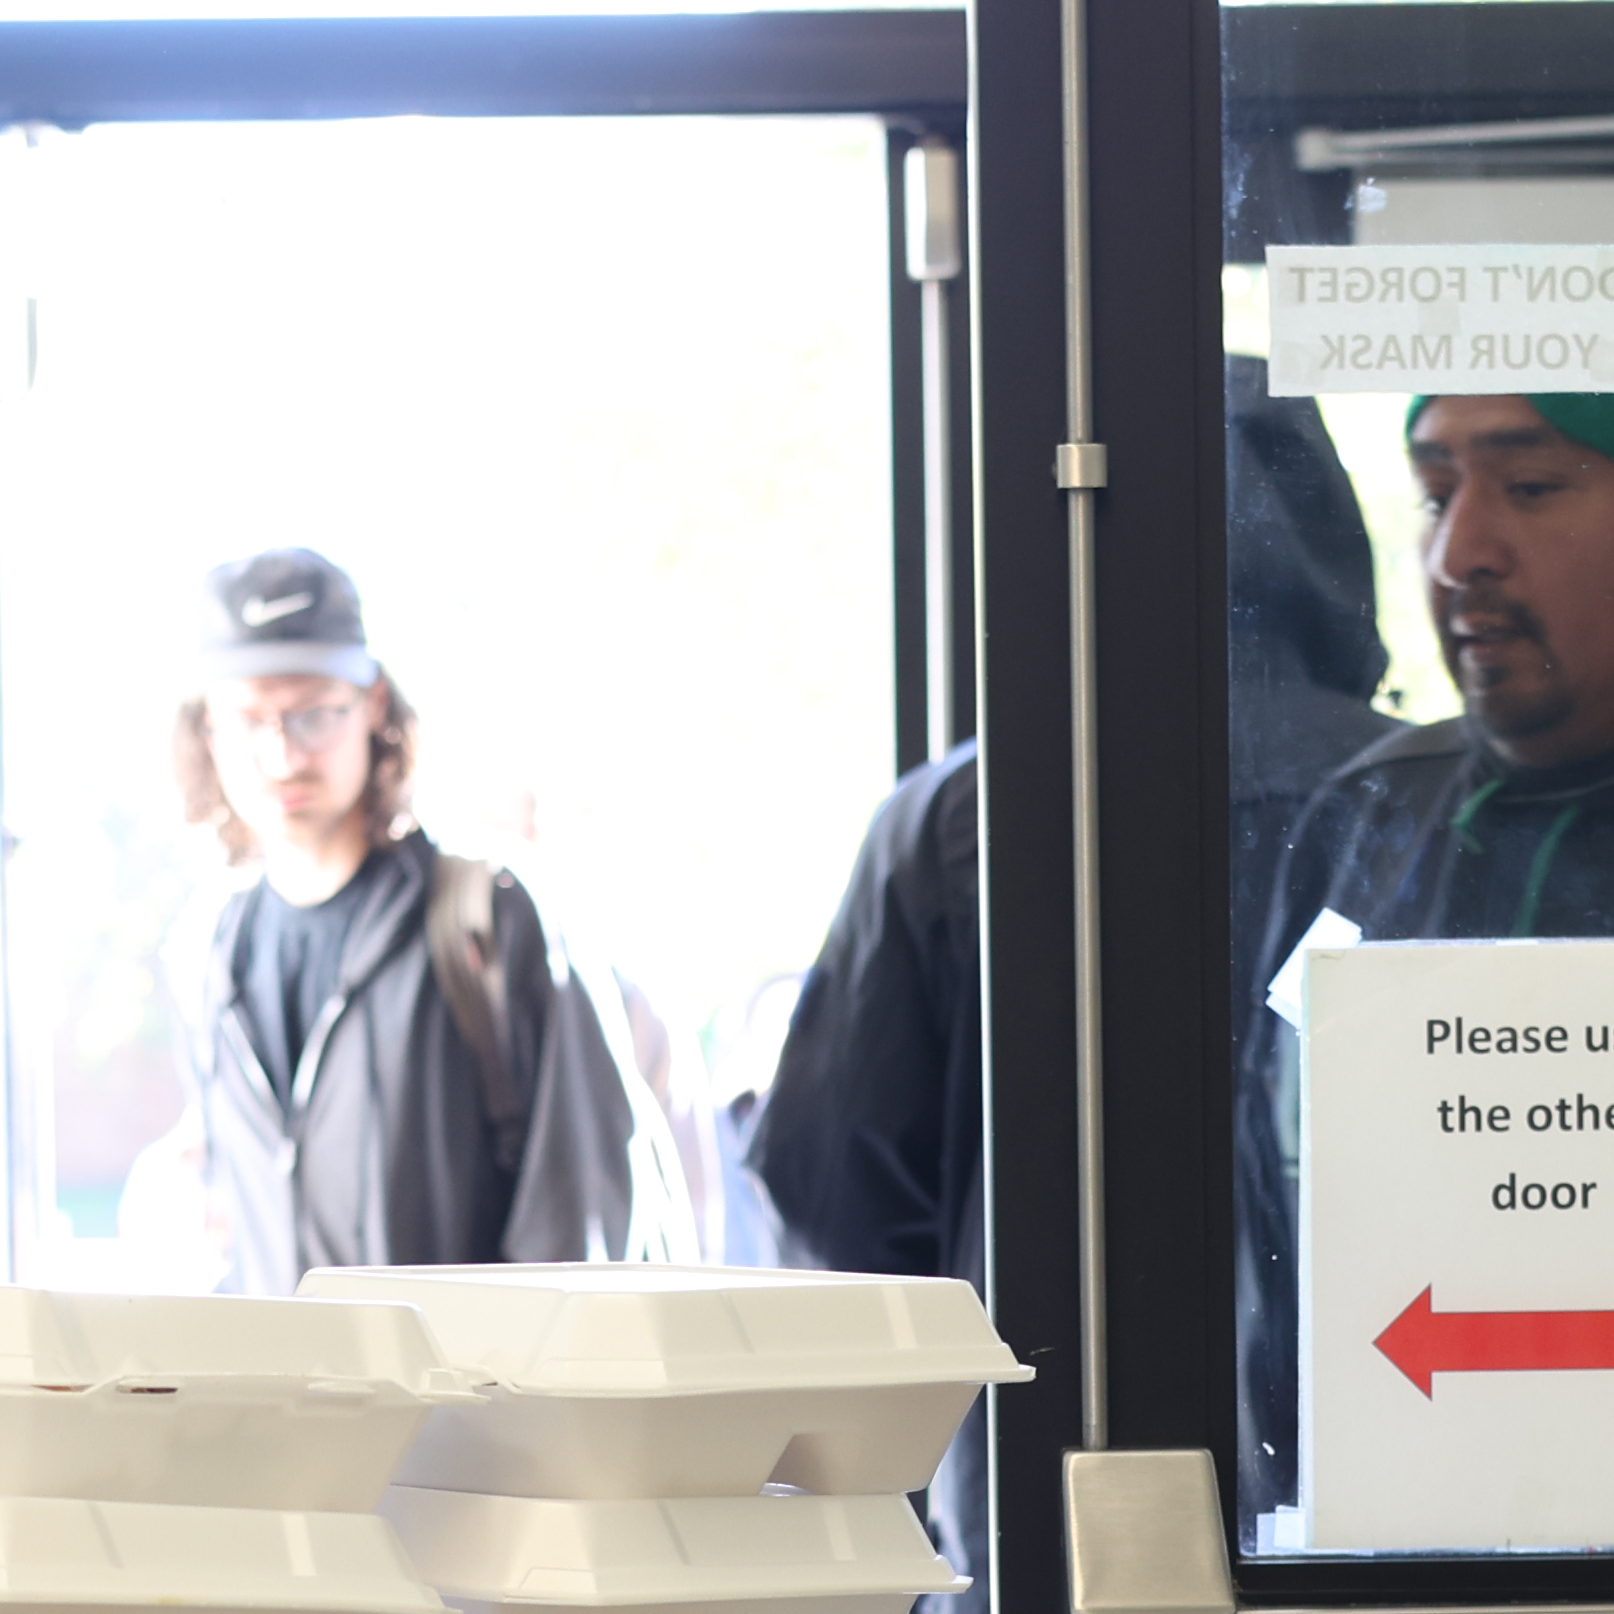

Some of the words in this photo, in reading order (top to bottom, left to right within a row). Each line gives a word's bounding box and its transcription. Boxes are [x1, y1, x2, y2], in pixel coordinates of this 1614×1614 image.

[1427, 1016, 1569, 1055] Please
[1437, 1094, 1511, 1133] the
[1492, 1172, 1597, 1211] door
